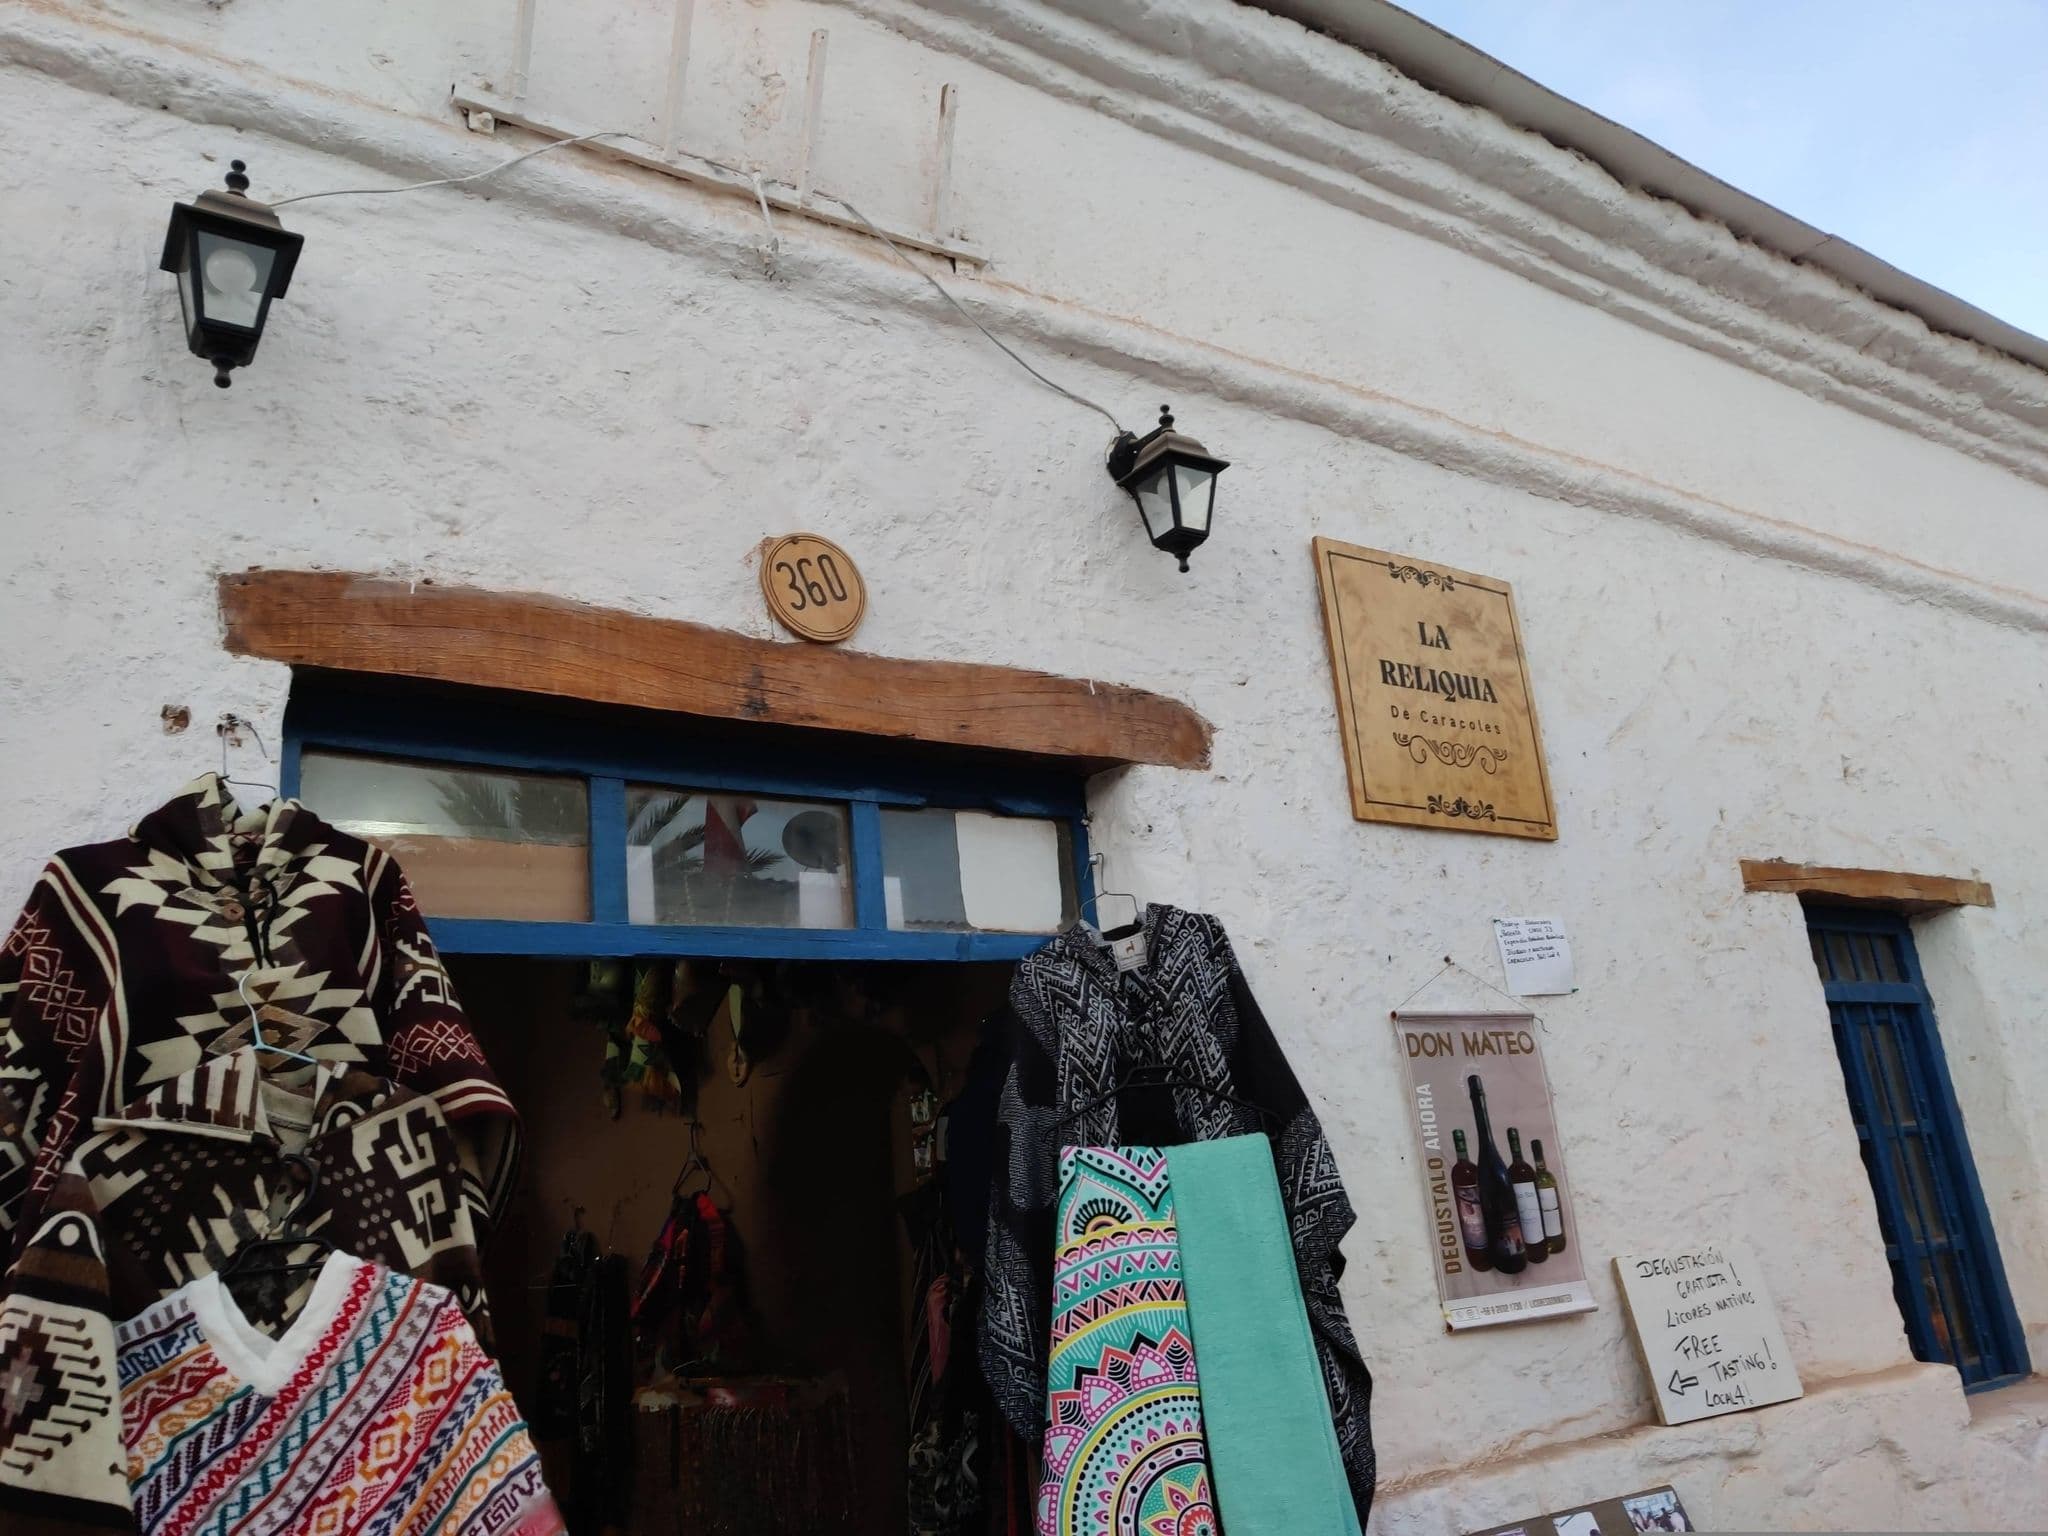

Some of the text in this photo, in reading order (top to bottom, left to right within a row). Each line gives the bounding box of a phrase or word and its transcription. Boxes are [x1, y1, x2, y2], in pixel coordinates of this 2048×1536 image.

[775, 554, 848, 611] 360
[1417, 620, 1452, 650] LA
[1379, 658, 1499, 704] RELIQUIA
[1390, 704, 1502, 735] De Caracoles
[1405, 1030, 1535, 1058] DON MATEO
[1415, 1082, 1462, 1275] DEGUSTALO AHORA
[1674, 1334, 1723, 1361] FREE
